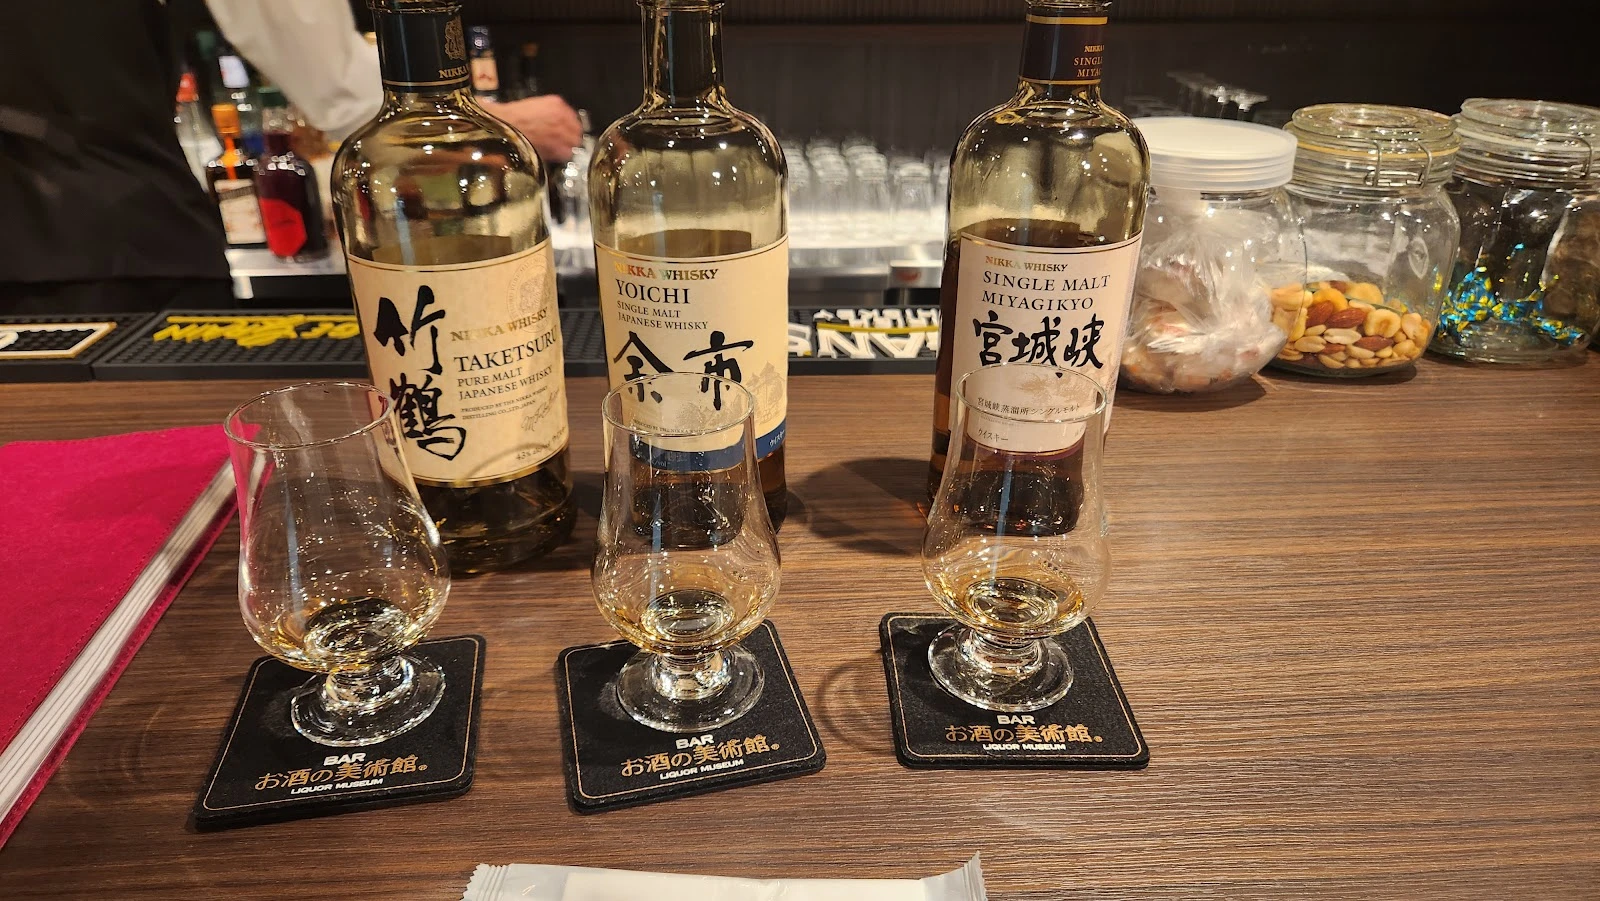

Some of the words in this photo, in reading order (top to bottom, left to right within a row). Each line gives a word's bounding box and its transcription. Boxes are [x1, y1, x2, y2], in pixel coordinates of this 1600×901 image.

[613, 262, 655, 279] NIKKA
[660, 268, 719, 281] WHISKY
[985, 256, 1021, 269] NIKKA
[1024, 262, 1068, 272] WHISKY
[615, 279, 691, 304] YOICHI
[983, 271, 1055, 291] SINGLE
[1061, 275, 1111, 292] MALT
[616, 300, 649, 316] SINGLE
[652, 308, 681, 318] MALT
[982, 290, 1093, 311] MIYAGIKYO
[450, 326, 504, 342] NIKKA
[507, 306, 548, 332] WHISKY
[618, 312, 662, 329] JAPANESE
[665, 321, 709, 330] WHISKY
[454, 326, 557, 372] TAKETSURU
[973, 310, 1105, 378] 宮城峡
[374, 285, 467, 461] 竹鶴
[457, 373, 489, 387] PURE
[492, 367, 523, 382] MALT
[613, 331, 754, 410] 余市
[459, 382, 518, 401] JAPANESE
[520, 365, 553, 388] WHISKY
[978, 429, 1008, 442] ウイスキー
[997, 715, 1035, 724] BAR
[676, 734, 714, 749] BAR
[323, 753, 367, 766] BAR
[660, 767, 698, 780] LIQUOR
[700, 759, 744, 772] MUSEUM
[290, 784, 332, 795] LIQUOR
[335, 778, 384, 789] MUSEUM
